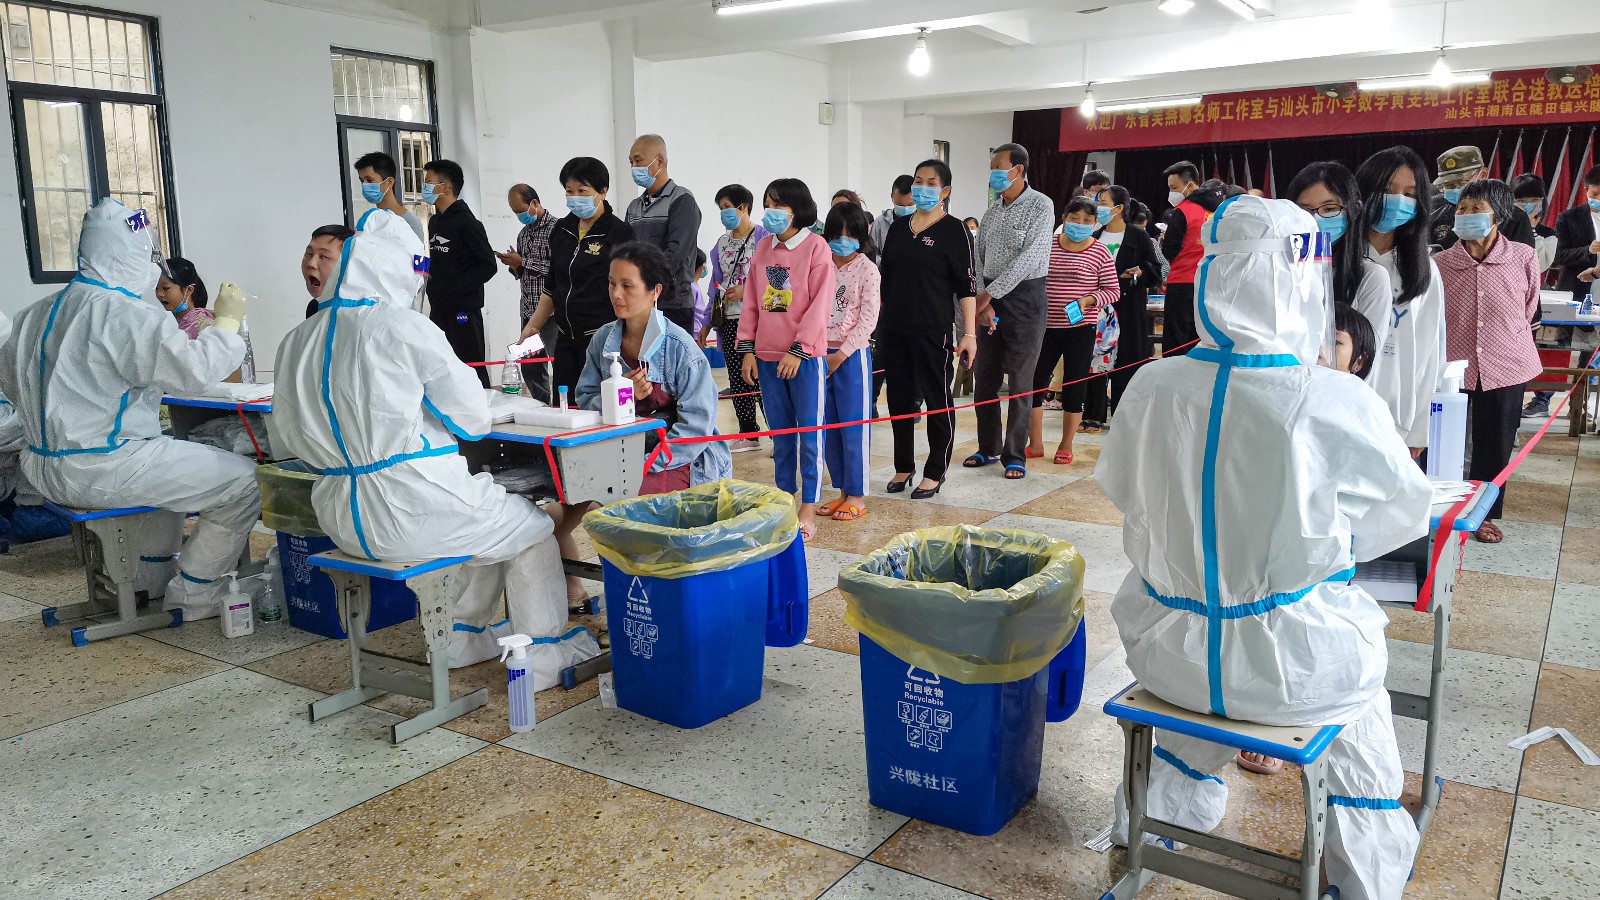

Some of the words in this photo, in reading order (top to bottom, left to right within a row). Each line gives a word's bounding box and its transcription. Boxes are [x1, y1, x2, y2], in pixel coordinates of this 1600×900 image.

[904, 682, 944, 697] 可回收物
[904, 692, 944, 706] Recyclable
[889, 765, 959, 794] 兴陇社区
